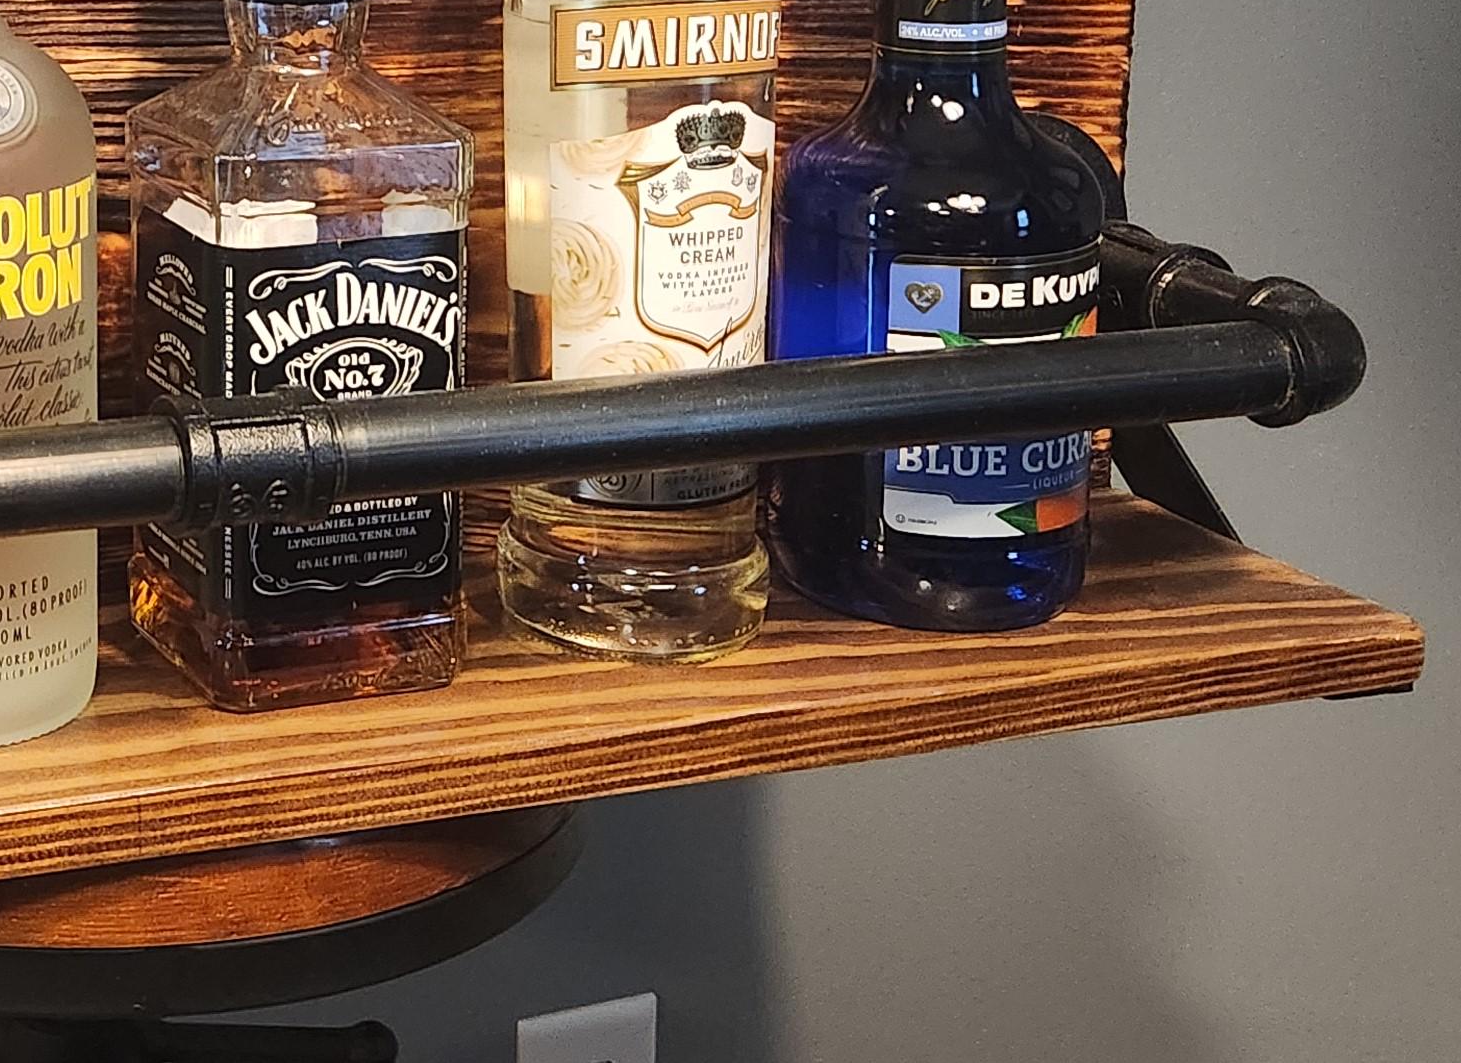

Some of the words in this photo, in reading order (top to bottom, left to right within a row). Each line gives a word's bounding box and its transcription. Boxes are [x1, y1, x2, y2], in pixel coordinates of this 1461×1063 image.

[576, 11, 780, 72] SMIRNOF
[668, 226, 744, 247] WHIPPED
[680, 246, 735, 265] CREAM
[658, 271, 700, 280] VODKA
[707, 262, 749, 278] INFUSED
[662, 281, 694, 289] WITH
[702, 273, 747, 288] NATURAL
[683, 285, 733, 298] FLAVORS
[970, 283, 1026, 309] DE
[1032, 262, 1101, 307] KUYP
[225, 291, 234, 333] EVERY
[245, 288, 335, 365] JACK
[335, 272, 462, 348] DANIEL'S
[225, 334, 234, 370] DROP
[338, 351, 371, 368] Old
[896, 444, 1007, 477] BLUE
[353, 497, 402, 511] BOTTLED
[404, 496, 418, 507] BY
[357, 509, 432, 525] DISTILLERY
[395, 526, 418, 537] USA
[37, 638, 68, 659] VODKA
